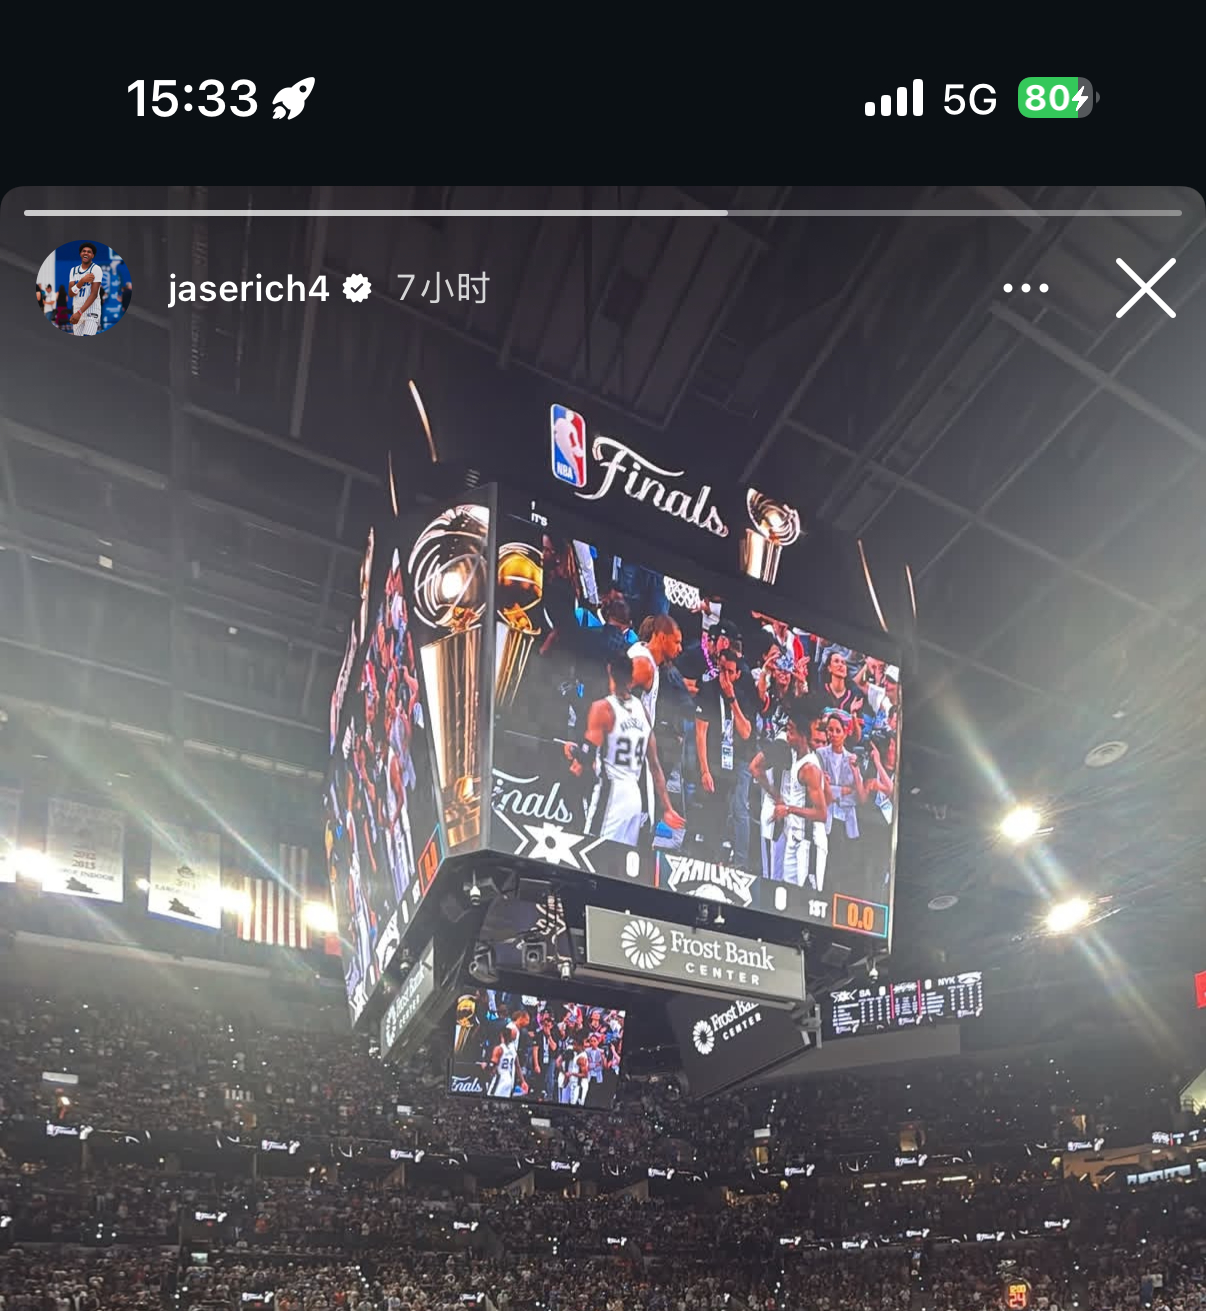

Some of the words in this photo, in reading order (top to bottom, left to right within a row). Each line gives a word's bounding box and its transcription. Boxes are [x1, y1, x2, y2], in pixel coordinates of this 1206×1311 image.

[556, 461, 574, 480] NBA
[574, 436, 729, 538] Finals
[614, 737, 645, 766] 24
[626, 851, 640, 878] 0
[775, 886, 787, 911] 0
[808, 899, 829, 918] 1ST
[847, 902, 875, 931] 0.0
[670, 929, 722, 961] Frost
[725, 945, 776, 972] Bank
[685, 962, 760, 986] CENTER
[709, 1005, 740, 1032] Frost
[722, 1012, 762, 1041] CENTER
[1009, 1292, 1026, 1308] 24
